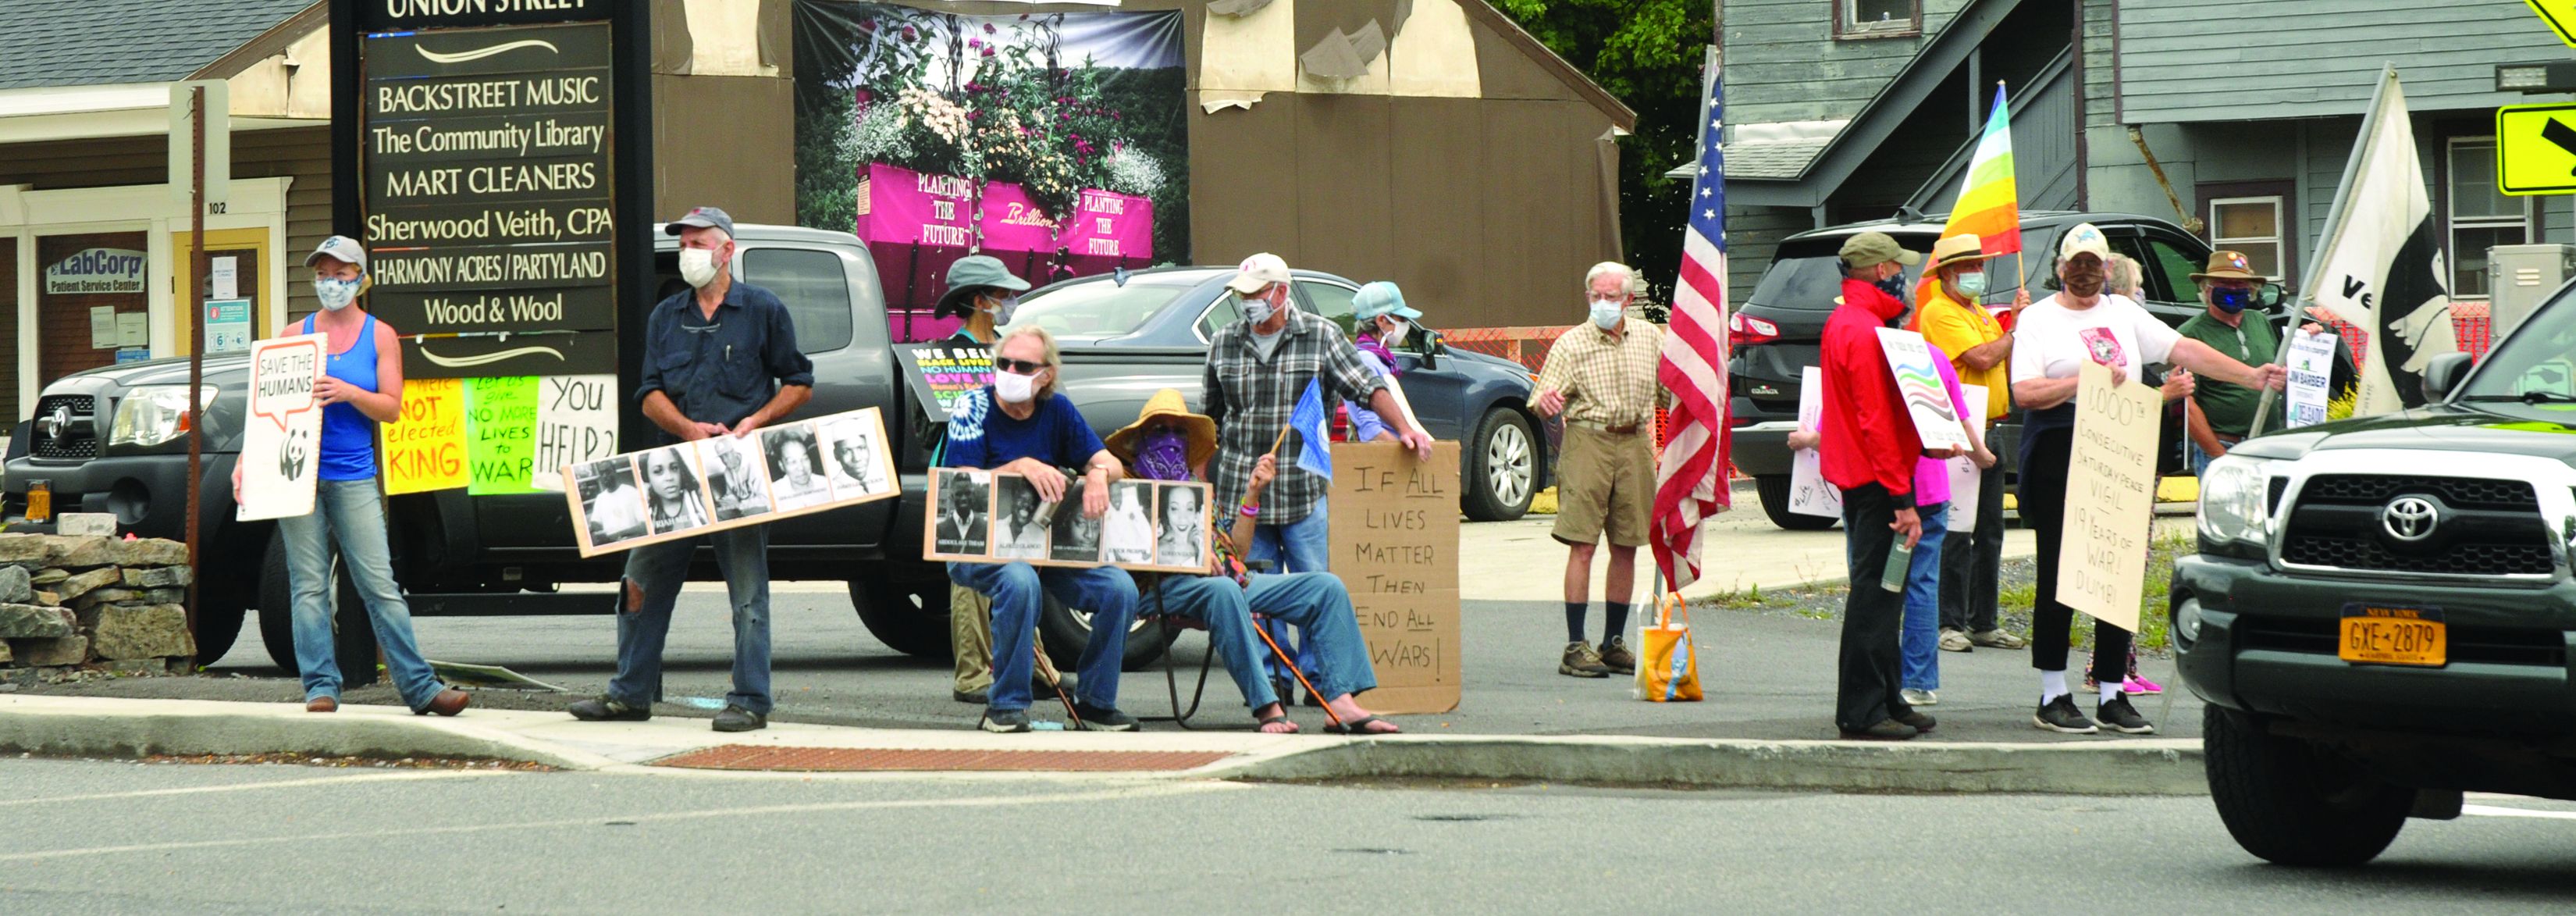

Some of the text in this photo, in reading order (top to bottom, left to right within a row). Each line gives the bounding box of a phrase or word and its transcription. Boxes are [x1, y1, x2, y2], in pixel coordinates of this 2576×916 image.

[379, 77, 600, 112] BACKSTREET MUSIC
[373, 119, 605, 156] The Community Library
[386, 162, 596, 197] MART CLEANERS
[918, 173, 970, 198] PLANTING
[209, 202, 226, 214] 102
[934, 200, 955, 220] THE
[1000, 202, 1060, 229] Brillion
[1084, 195, 1124, 215] PLANTING
[367, 208, 614, 241] Sherwood Veith, CPA
[923, 223, 965, 246] FUTURE
[1096, 218, 1112, 234] THE
[1088, 238, 1119, 255] FUTURE
[59, 250, 142, 278] LabCorp
[374, 256, 453, 285] HARMONY
[456, 255, 502, 282] ACRES
[513, 251, 606, 281] PARTYLAND
[52, 280, 140, 291] Patient Service Center
[2343, 274, 2373, 311] Ve
[425, 293, 563, 325] Wood & Wool
[260, 354, 312, 376] SAVE THE
[912, 348, 992, 359] WE BEL
[258, 376, 312, 397] HUMANS
[924, 373, 974, 383] LOVE
[551, 376, 604, 412] YOU
[399, 397, 442, 422] NOT
[468, 406, 537, 424] NO MORE
[388, 418, 456, 444] elected
[481, 427, 529, 441] LIVES
[496, 444, 511, 454] to
[390, 442, 460, 482] KING
[470, 458, 533, 483] WAR
[2077, 447, 2144, 494] SATURDAY PEACE
[1354, 467, 1444, 495] IF ALL
[2090, 479, 2124, 511] VIGIL
[1367, 508, 1425, 529] LIVES
[2074, 506, 2133, 551] 19 YEARS OF
[1356, 542, 1433, 565] MATTER
[2087, 543, 2122, 576] WAR!
[1366, 575, 1425, 593] THEN
[2076, 570, 2118, 608] DUMB!
[1356, 606, 1435, 629] END ALL
[1370, 637, 1442, 683] WARS!
